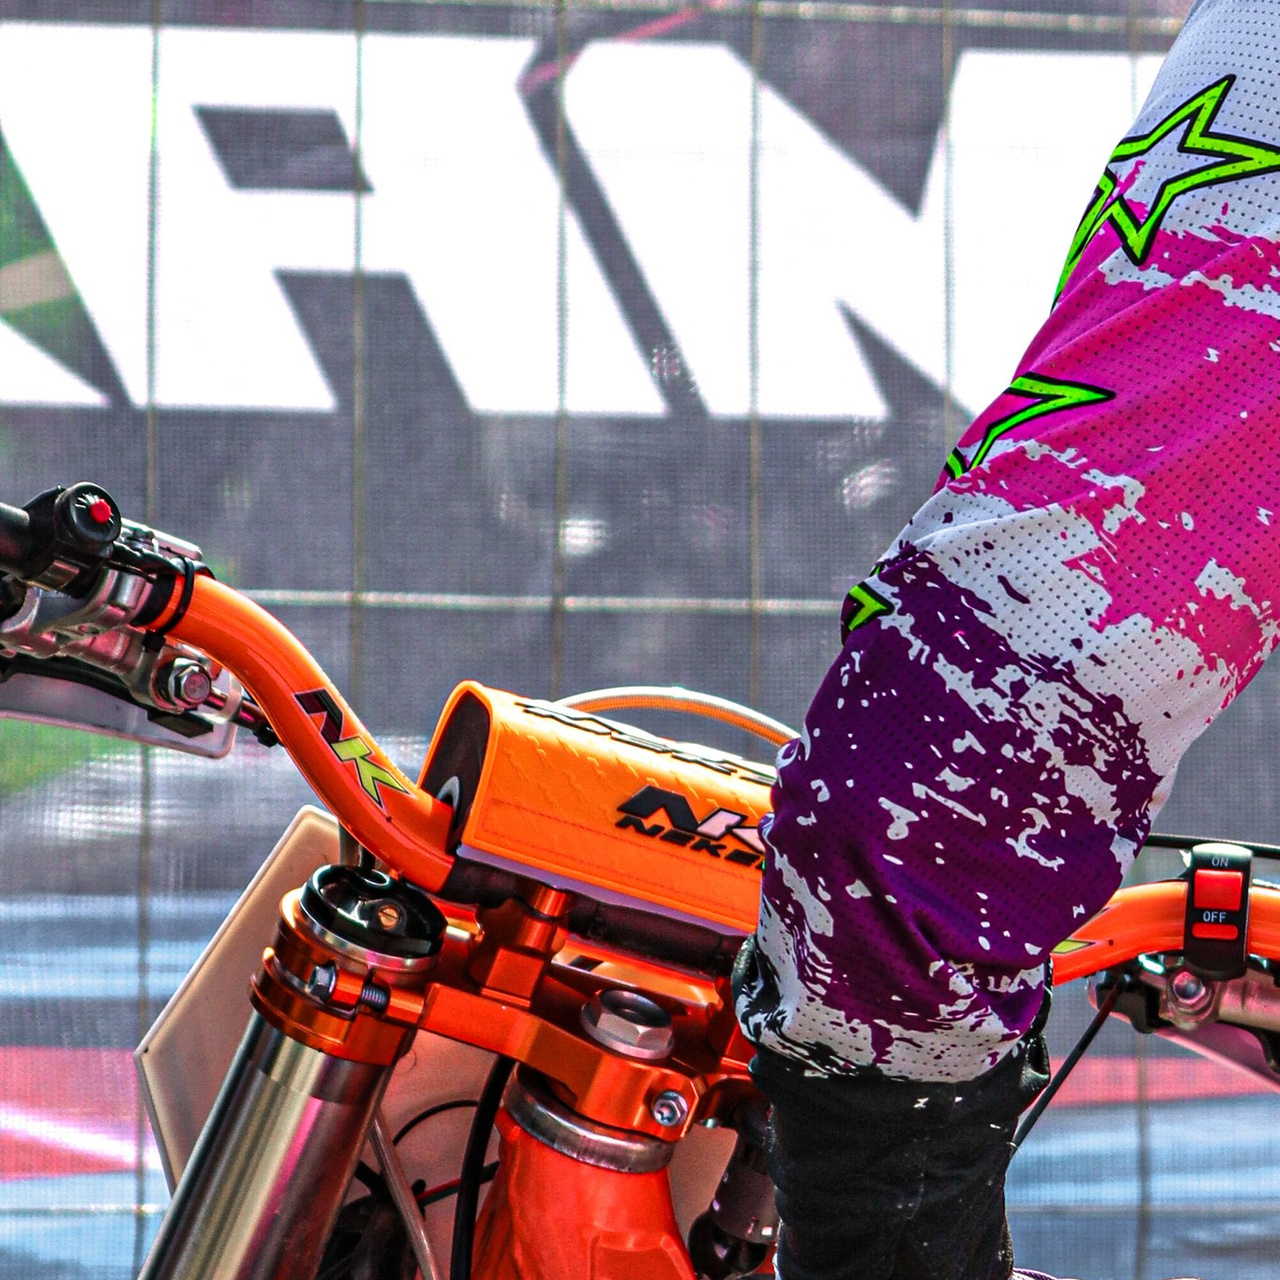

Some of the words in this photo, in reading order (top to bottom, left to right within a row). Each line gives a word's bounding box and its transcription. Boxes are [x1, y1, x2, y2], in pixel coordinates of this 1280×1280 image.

[615, 815, 766, 870] NEKE
[1211, 856, 1229, 868] ON
[1202, 911, 1227, 923] OFF
